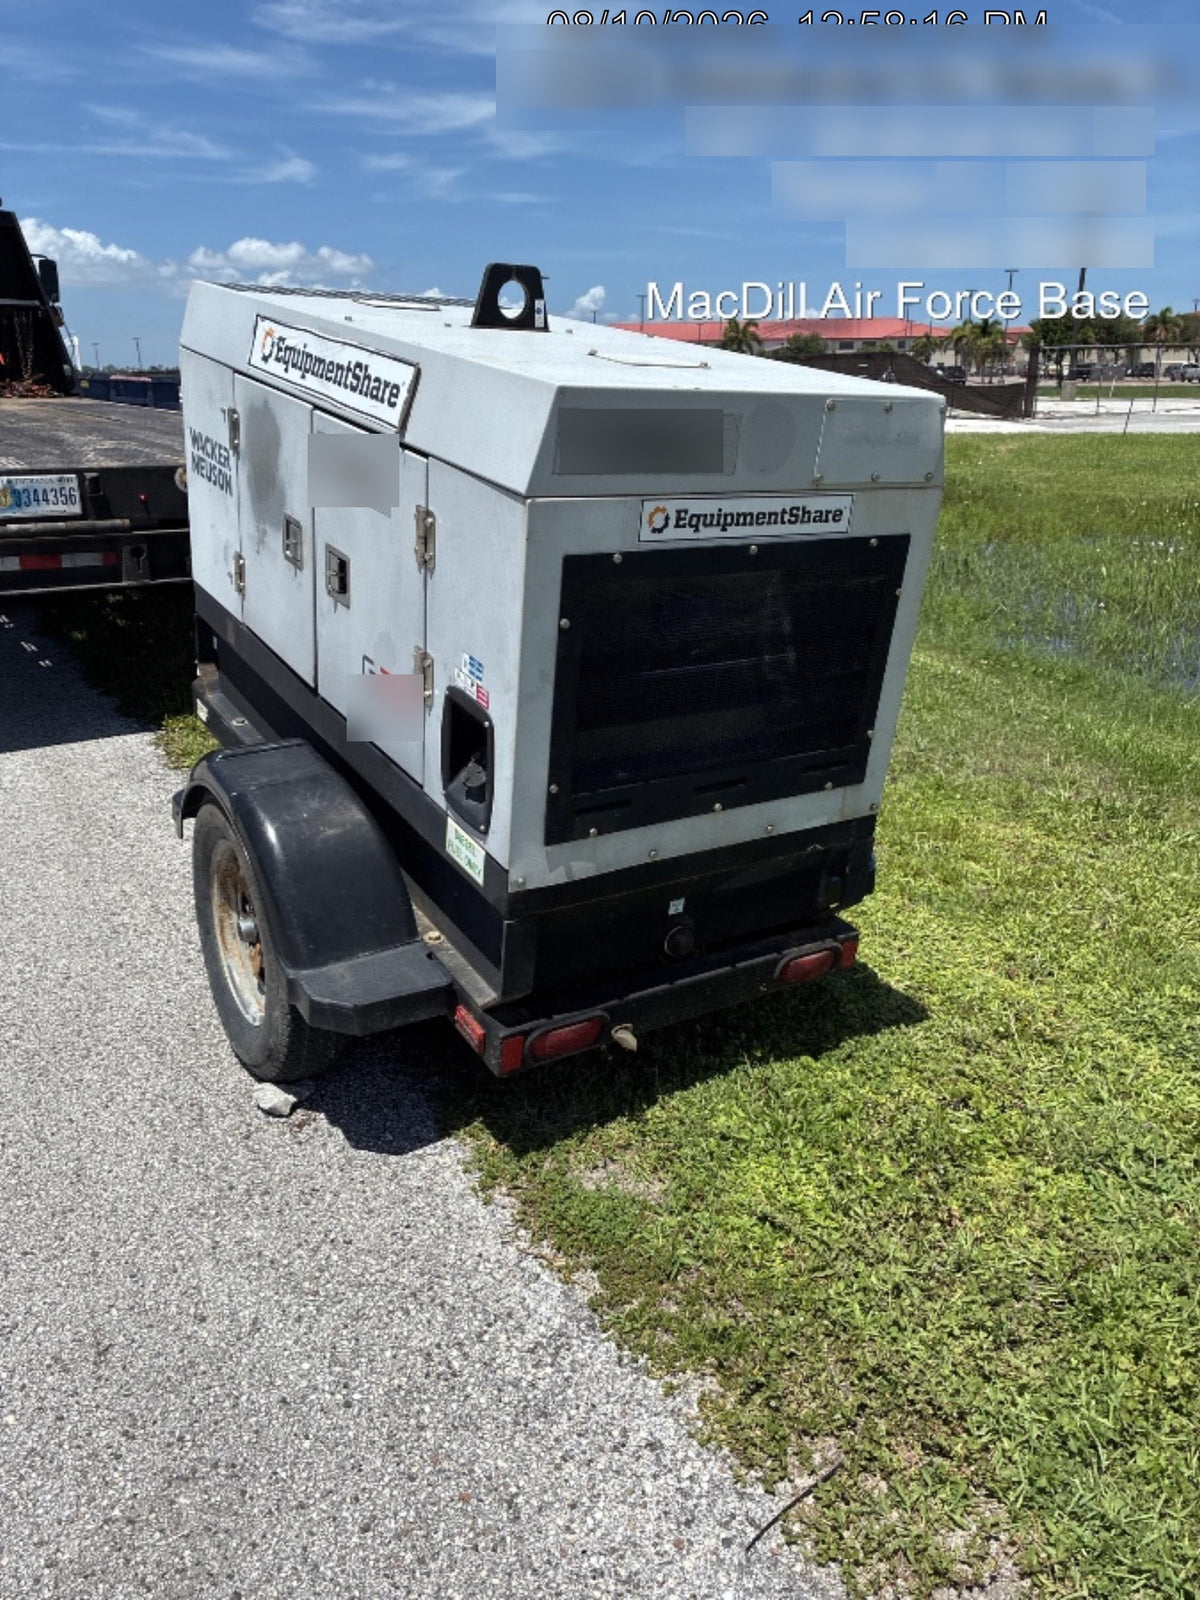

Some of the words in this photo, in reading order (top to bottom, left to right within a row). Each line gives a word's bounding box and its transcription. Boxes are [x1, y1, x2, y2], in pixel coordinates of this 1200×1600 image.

[274, 335, 401, 408] EquipmentShare
[189, 426, 231, 472] WACKER
[191, 450, 233, 498] NEUSON
[673, 504, 844, 533] EquipmentShare
